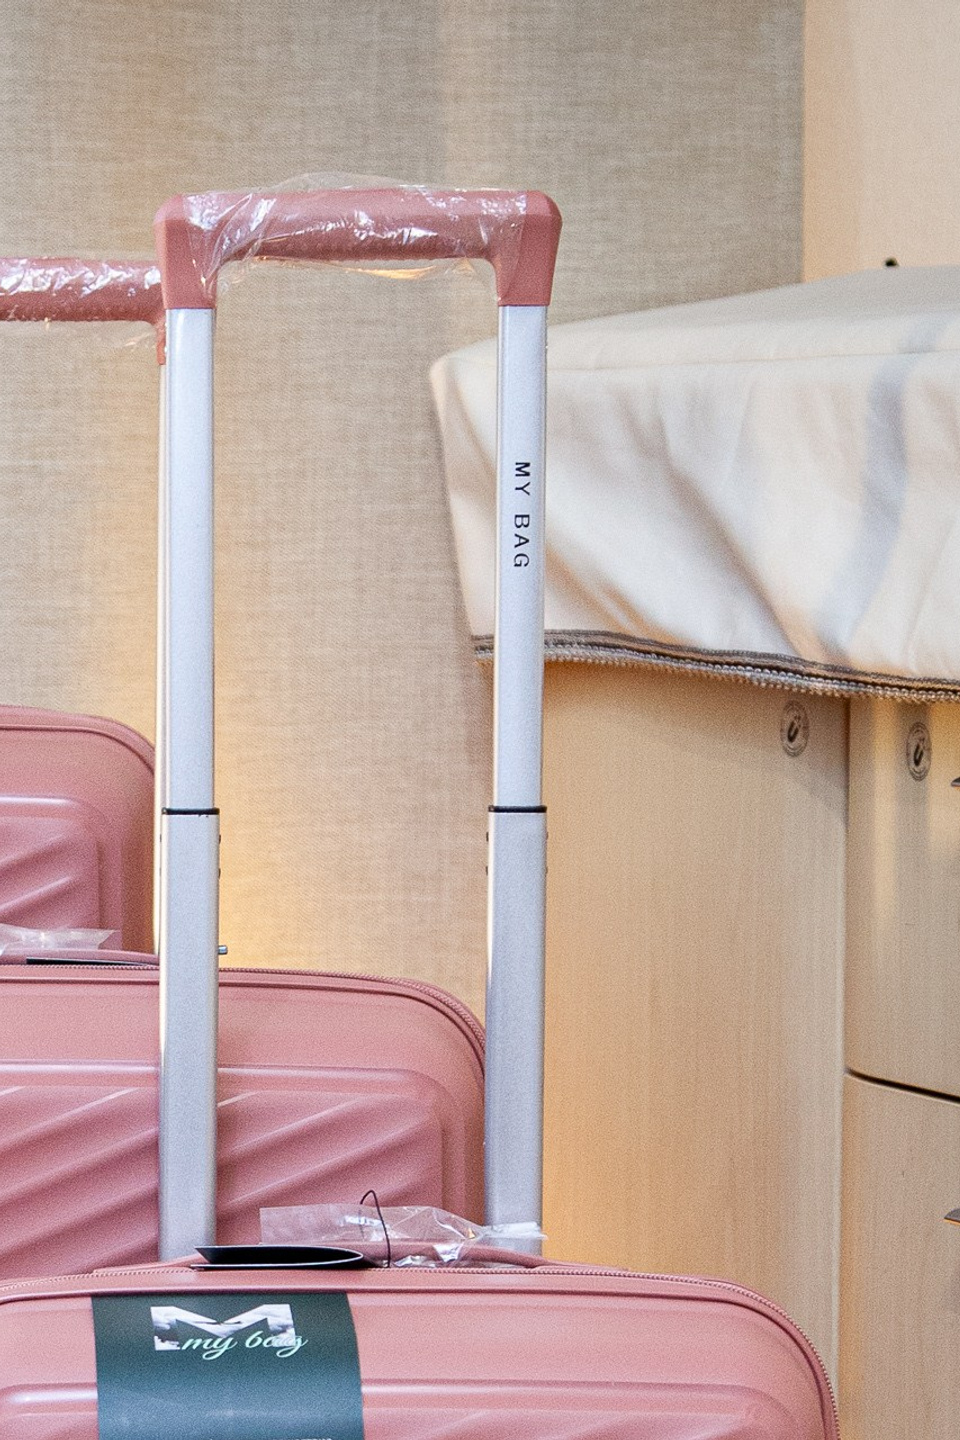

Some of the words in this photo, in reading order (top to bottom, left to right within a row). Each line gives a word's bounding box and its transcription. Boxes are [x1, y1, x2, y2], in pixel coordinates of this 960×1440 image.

[515, 462, 531, 496] MY
[514, 514, 530, 567] BAG
[182, 1337, 237, 1360] my
[245, 1331, 308, 1358] bag
